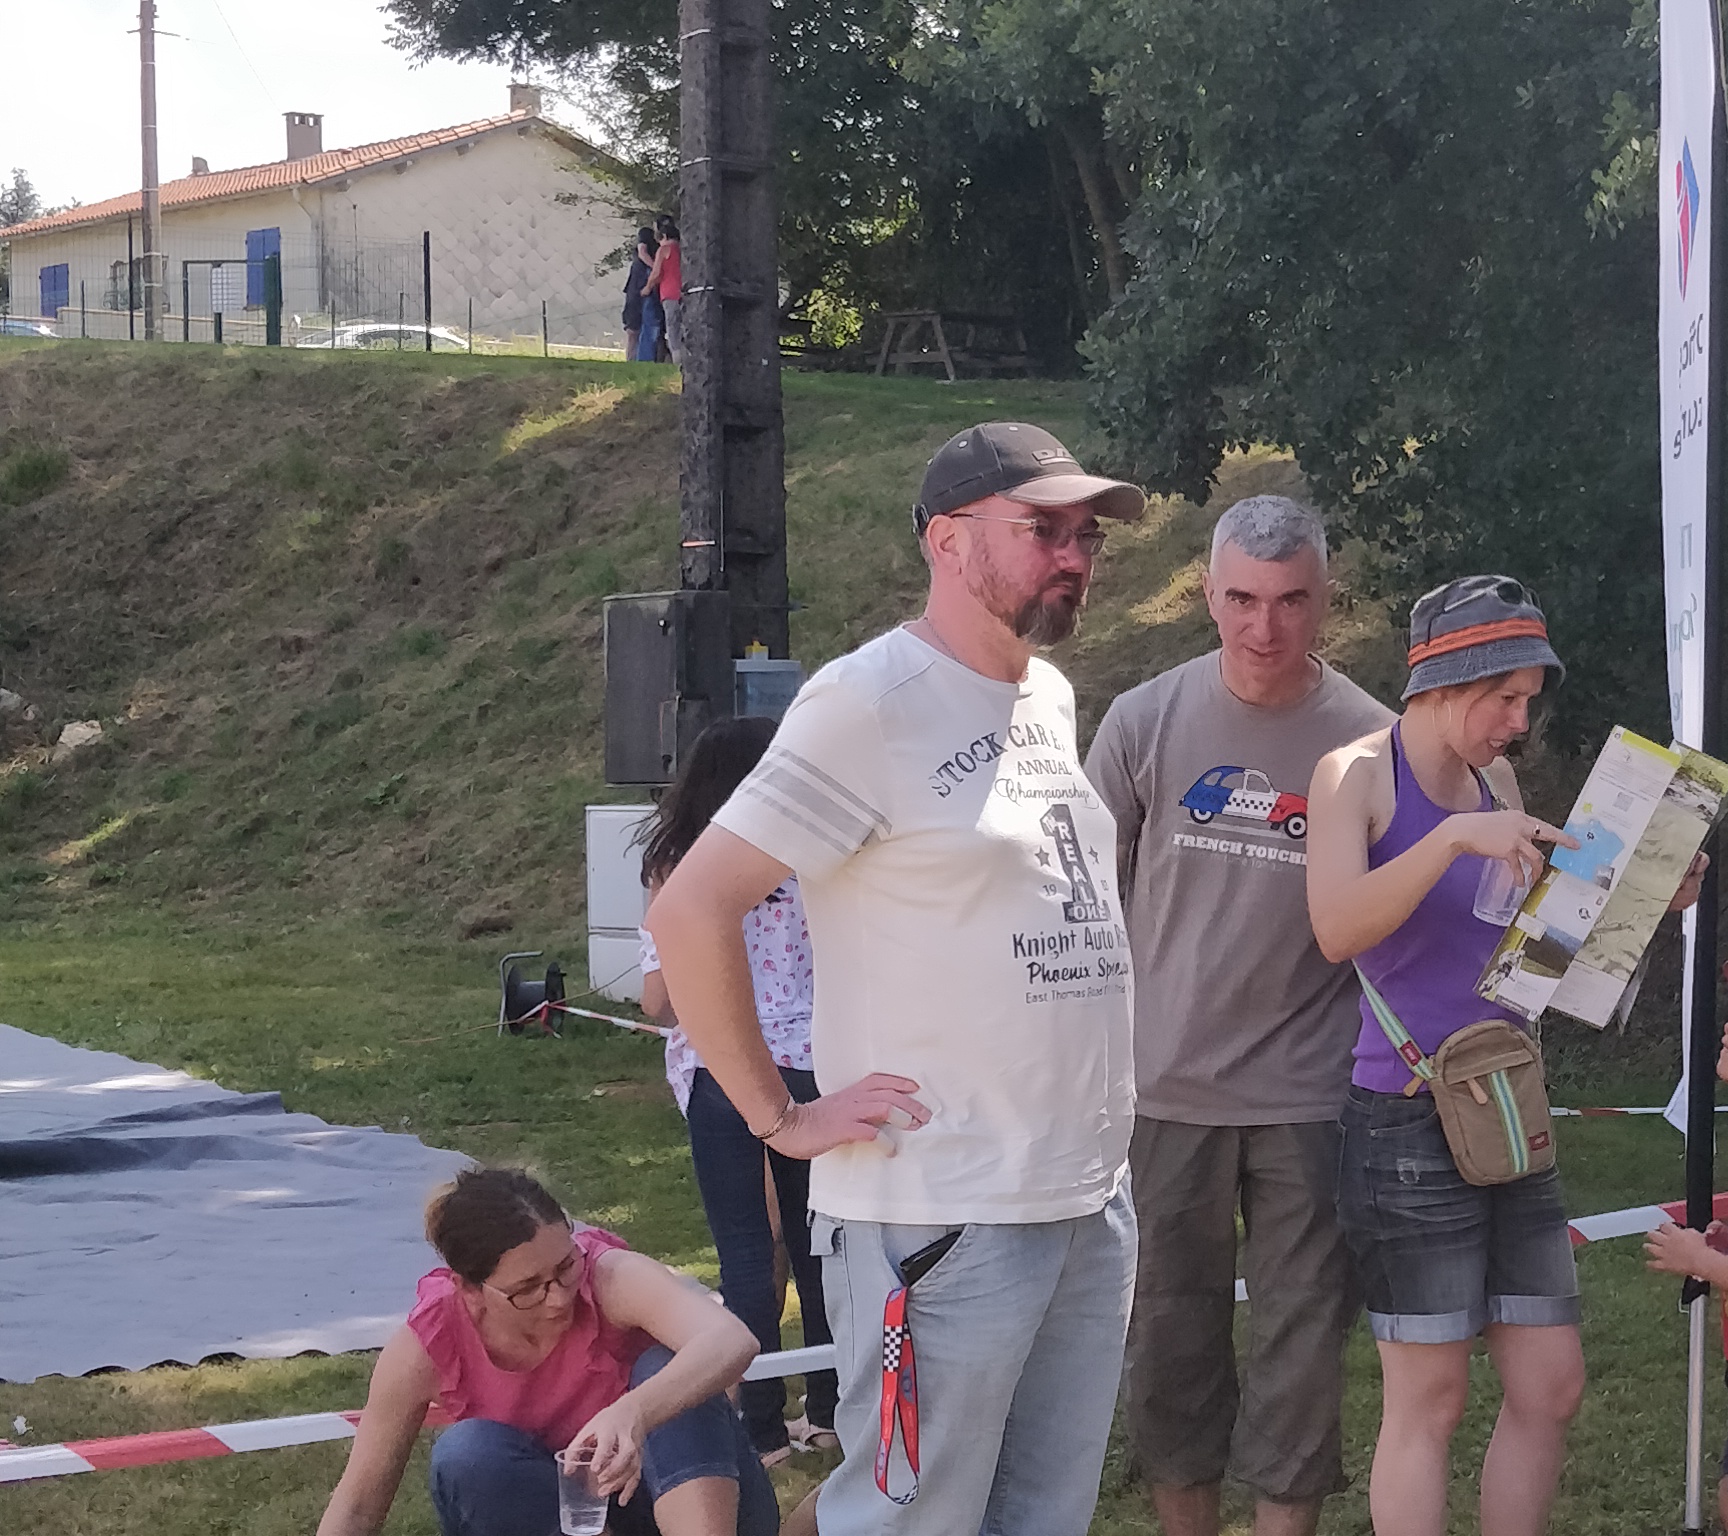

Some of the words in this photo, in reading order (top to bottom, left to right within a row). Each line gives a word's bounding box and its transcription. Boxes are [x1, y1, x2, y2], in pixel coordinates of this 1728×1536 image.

[928, 731, 1008, 799] STOCK
[1017, 759, 1072, 776] ANNUAL
[1173, 833, 1243, 855] FRENCH
[1056, 821, 1095, 904] REAL
[1042, 884, 1057, 897] 19
[1073, 900, 1108, 921] ONE
[1012, 929, 1077, 960] Knight
[1084, 926, 1114, 951] Auto
[1026, 960, 1092, 985] Phoenix
[1025, 991, 1048, 1004] East
[1051, 987, 1086, 1002] Thomas
